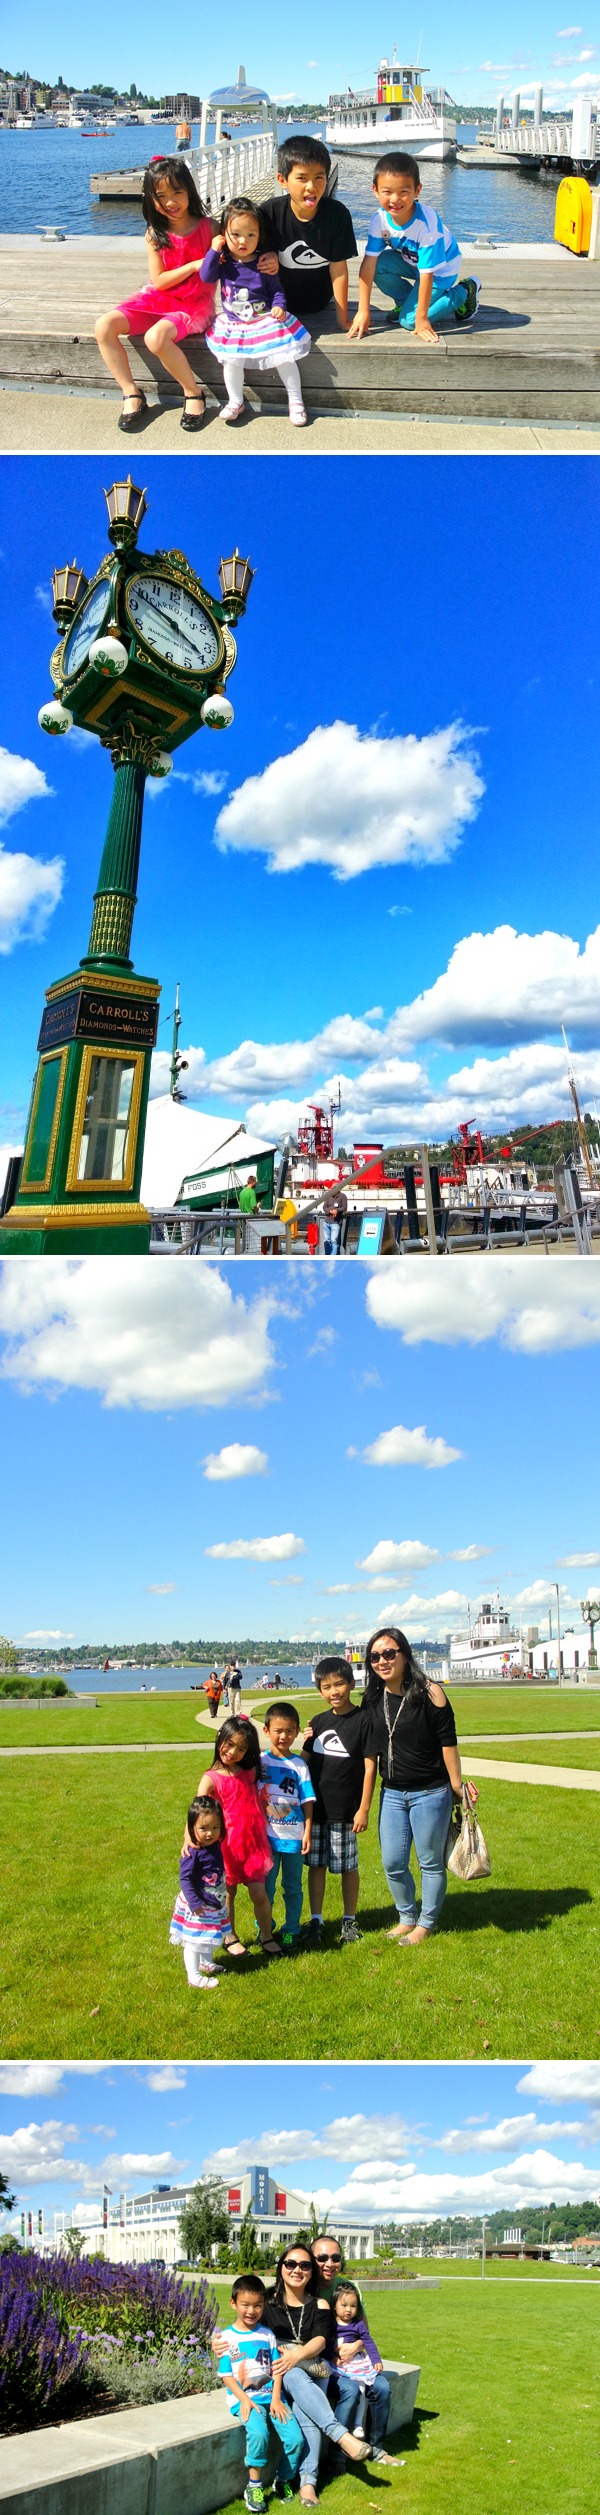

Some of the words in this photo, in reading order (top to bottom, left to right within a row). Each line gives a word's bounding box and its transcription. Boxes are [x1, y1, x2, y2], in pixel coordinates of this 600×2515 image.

[152, 584, 161, 596] 11
[129, 598, 138, 611] 9
[169, 591, 181, 606] 12
[149, 597, 198, 630] CARROLL'S
[190, 607, 194, 617] 1
[135, 617, 143, 631] 8
[199, 623, 207, 635] 2
[147, 637, 157, 645] 7
[203, 642, 212, 654] 3
[165, 651, 174, 661] 6
[197, 654, 206, 665] 4
[184, 656, 192, 669] 5
[89, 1002, 149, 1022] CARROLL'S
[188, 1181, 207, 1192] FOSS
[279, 1776, 296, 1796] 45
[254, 2348, 271, 2366] 45
